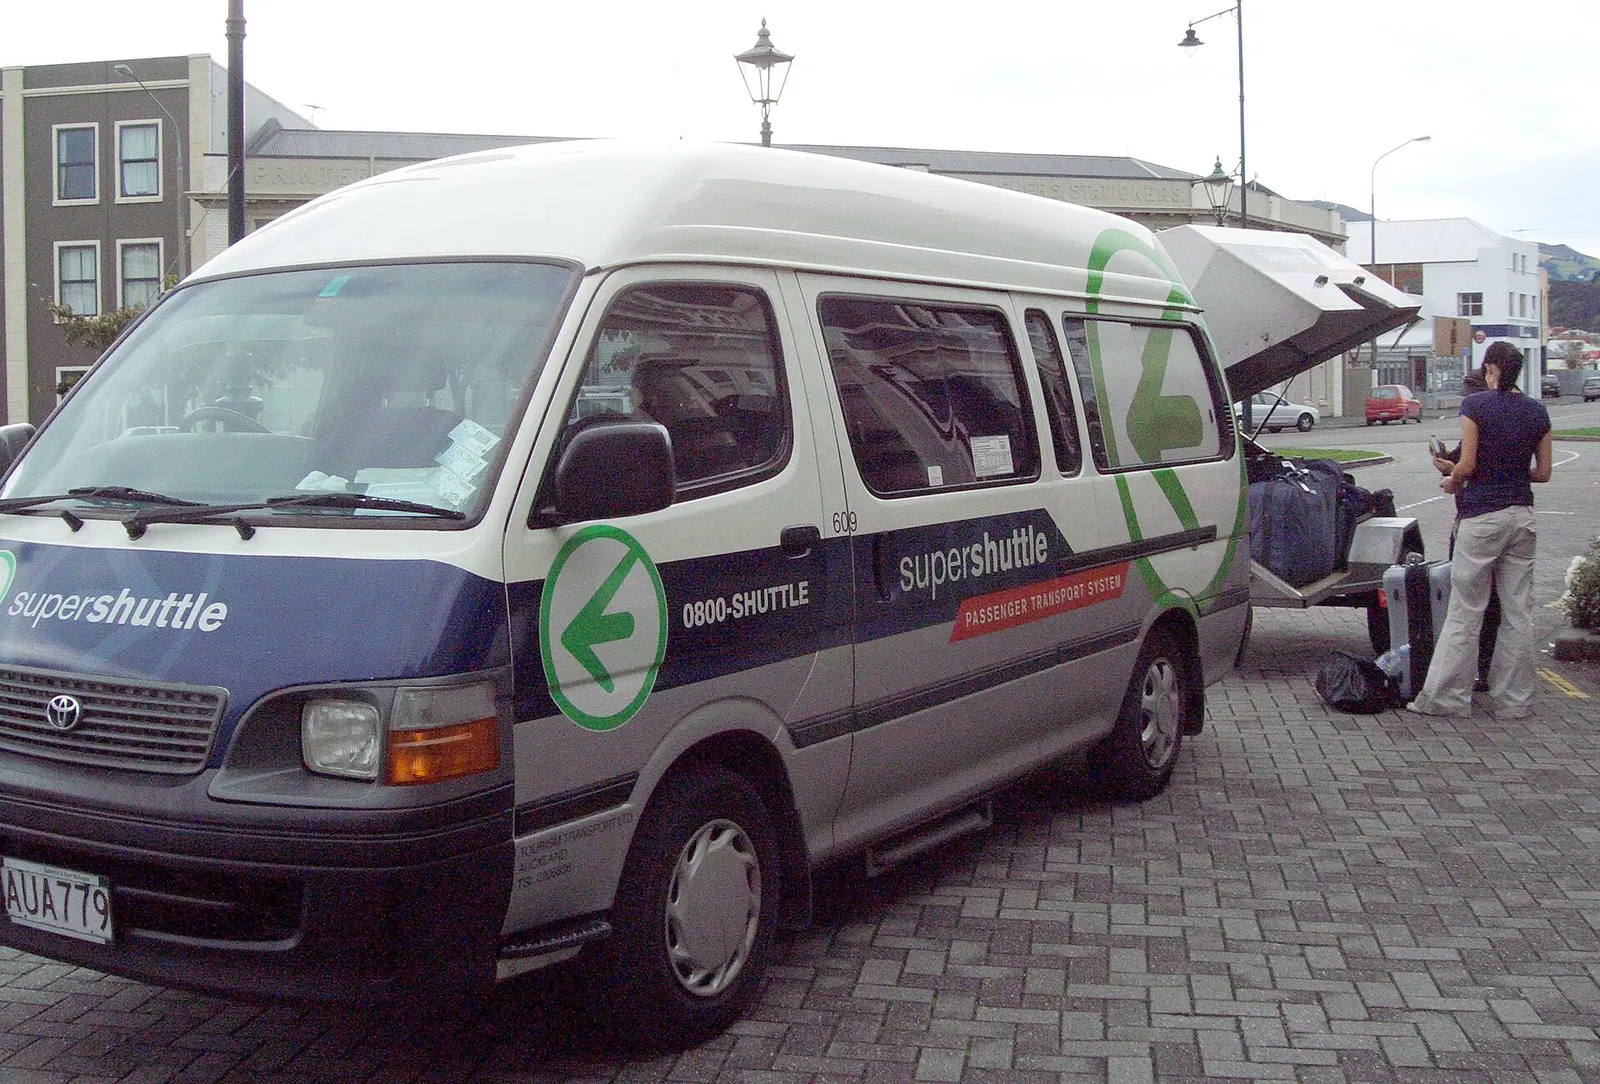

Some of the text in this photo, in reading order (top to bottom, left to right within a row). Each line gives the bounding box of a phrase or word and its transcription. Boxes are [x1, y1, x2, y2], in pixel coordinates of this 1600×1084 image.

[832, 511, 858, 534] 609
[899, 524, 1049, 600] supershuttle
[8, 588, 228, 632] supershuttle
[682, 580, 810, 629] 0800-SHUTTLE
[965, 574, 1122, 627] PASSENGER TRANSPORT SYSTEM
[7, 869, 108, 931] AUA779
